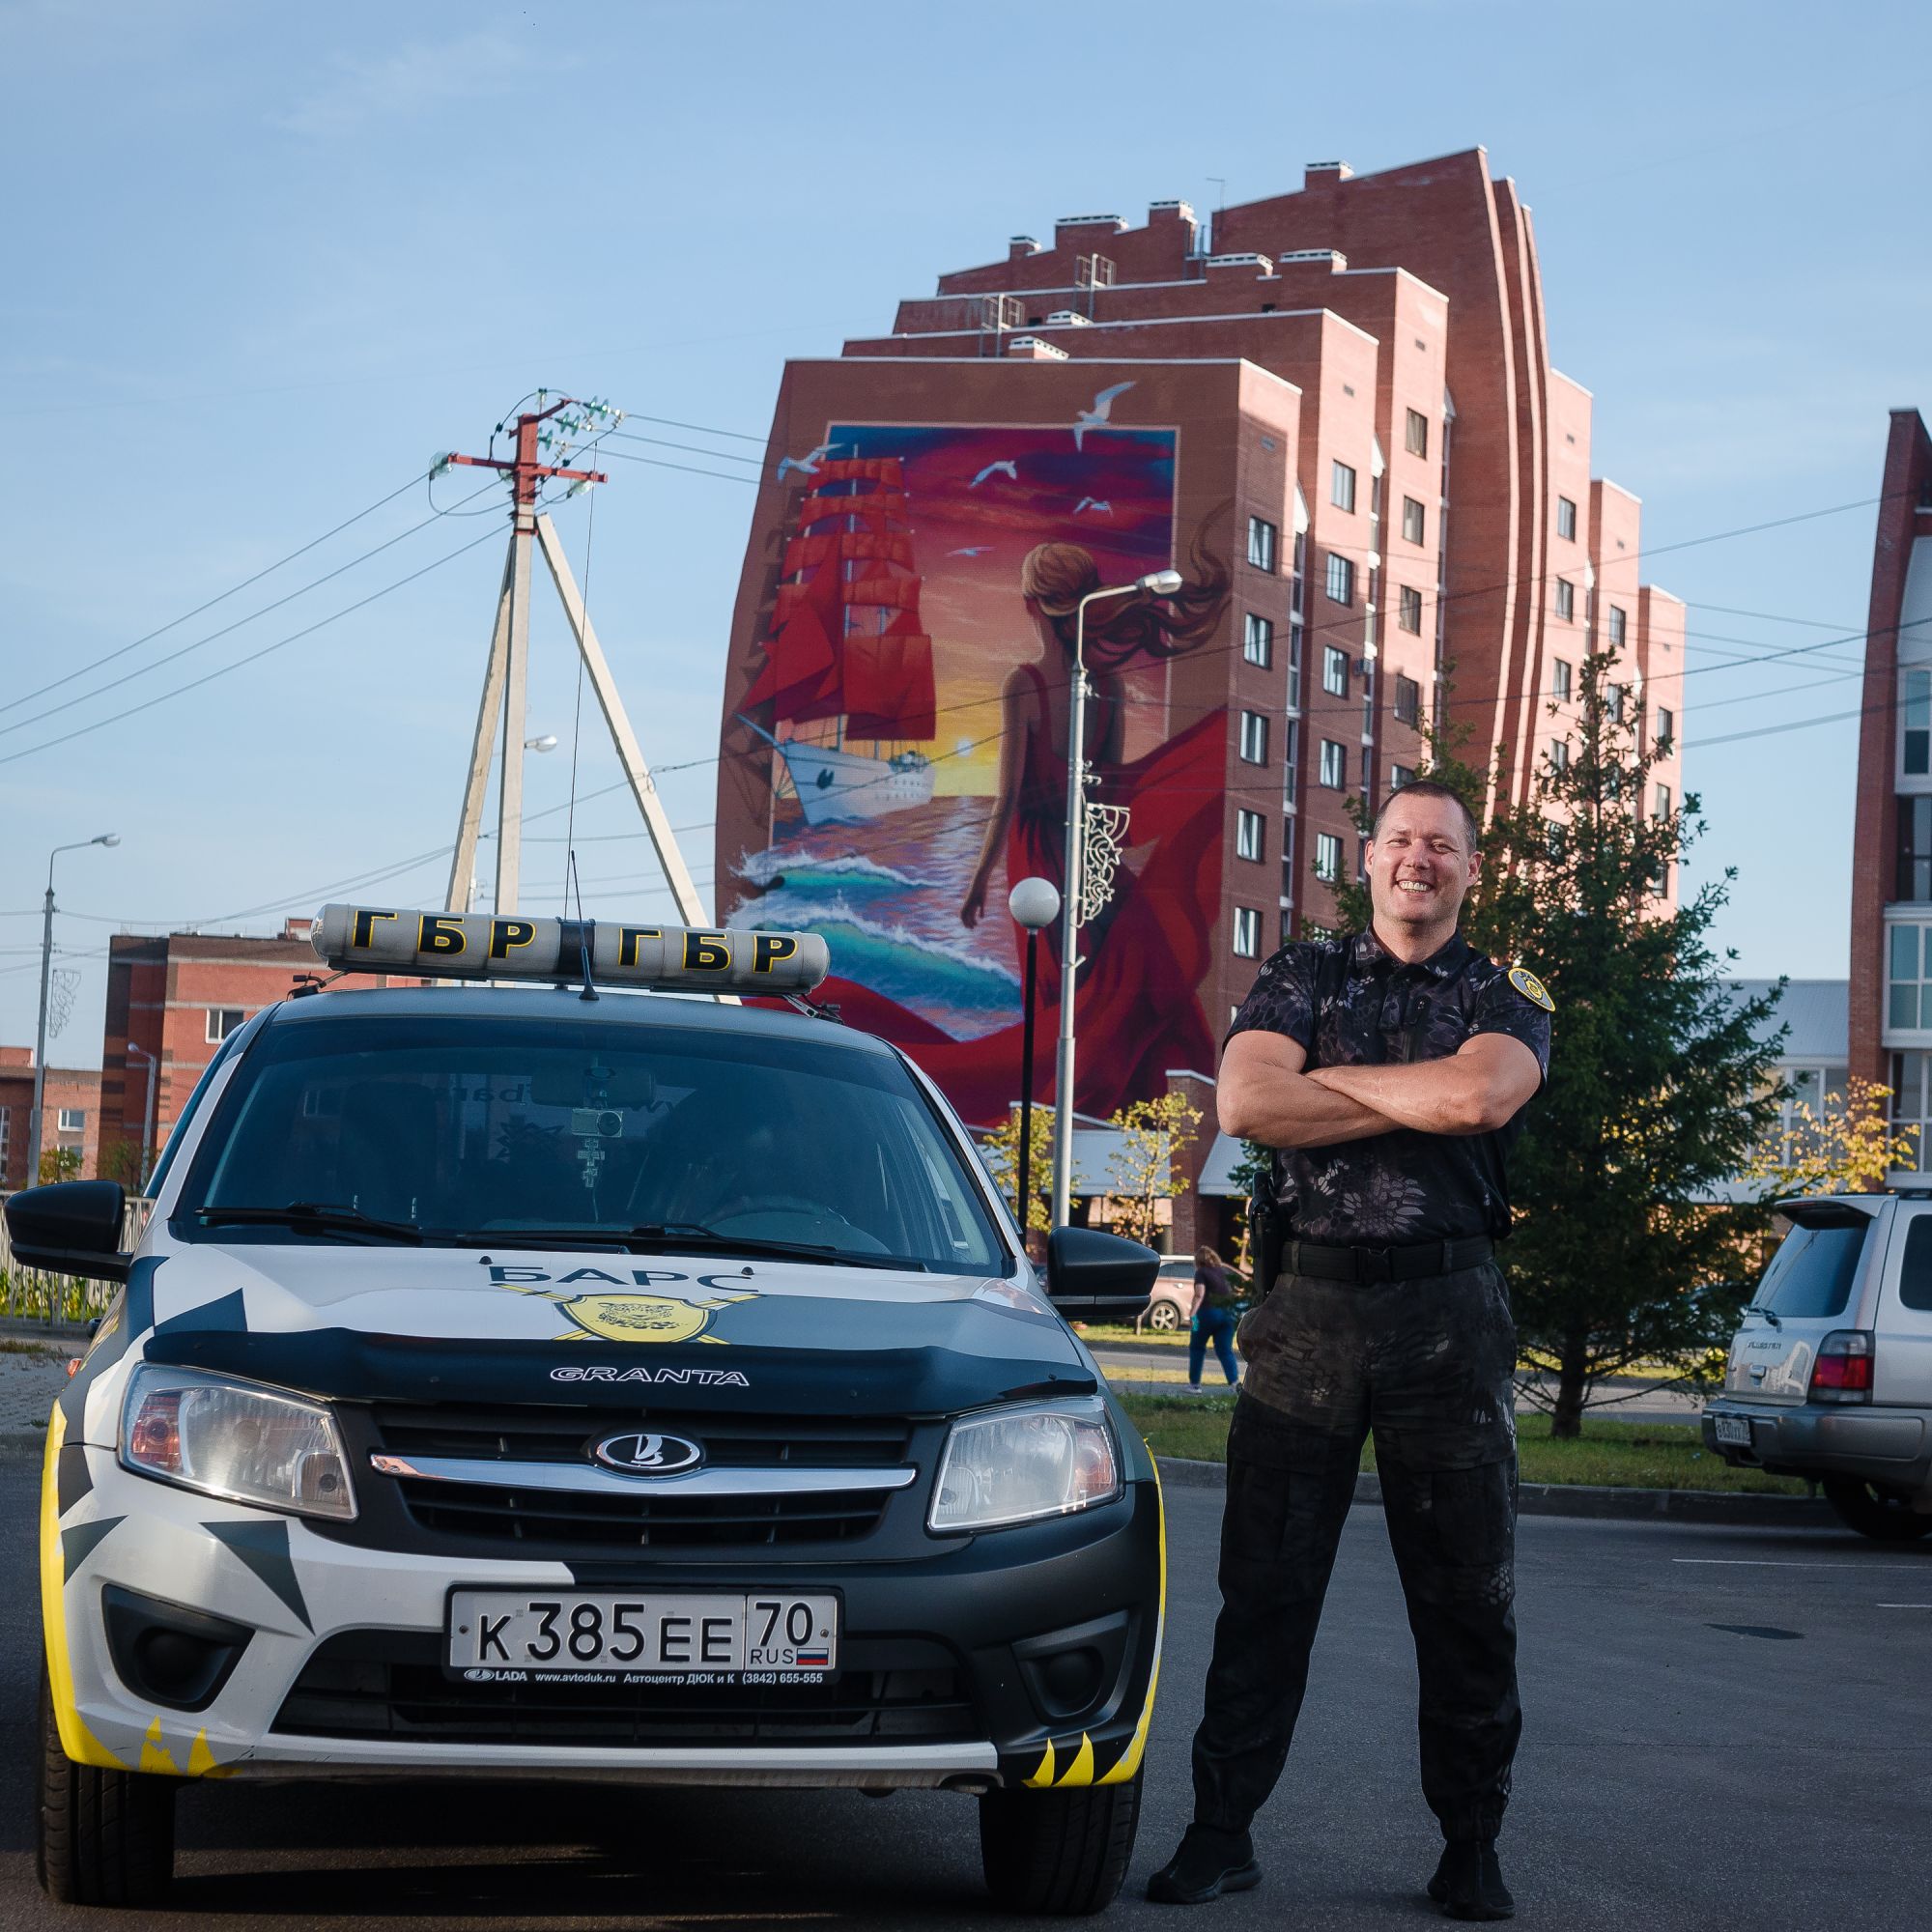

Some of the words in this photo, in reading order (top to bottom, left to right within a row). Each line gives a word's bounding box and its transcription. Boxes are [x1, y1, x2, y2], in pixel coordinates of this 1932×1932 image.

[352, 910, 537, 959] ГБР
[618, 927, 798, 974] ГБР
[489, 1265, 759, 1293] БАРС
[550, 1366, 750, 1386] GRANTA
[754, 1602, 813, 1647] 70
[750, 1648, 794, 1665] RUS
[495, 1670, 528, 1682] LADA
[535, 1672, 616, 1683] www.avtoduk.ru
[624, 1673, 685, 1685] Автоцентр
[687, 1673, 714, 1685] ДЮК
[717, 1675, 724, 1684] и
[726, 1673, 735, 1684] К
[742, 1672, 777, 1685] (3842)
[780, 1673, 823, 1684] 655-555
